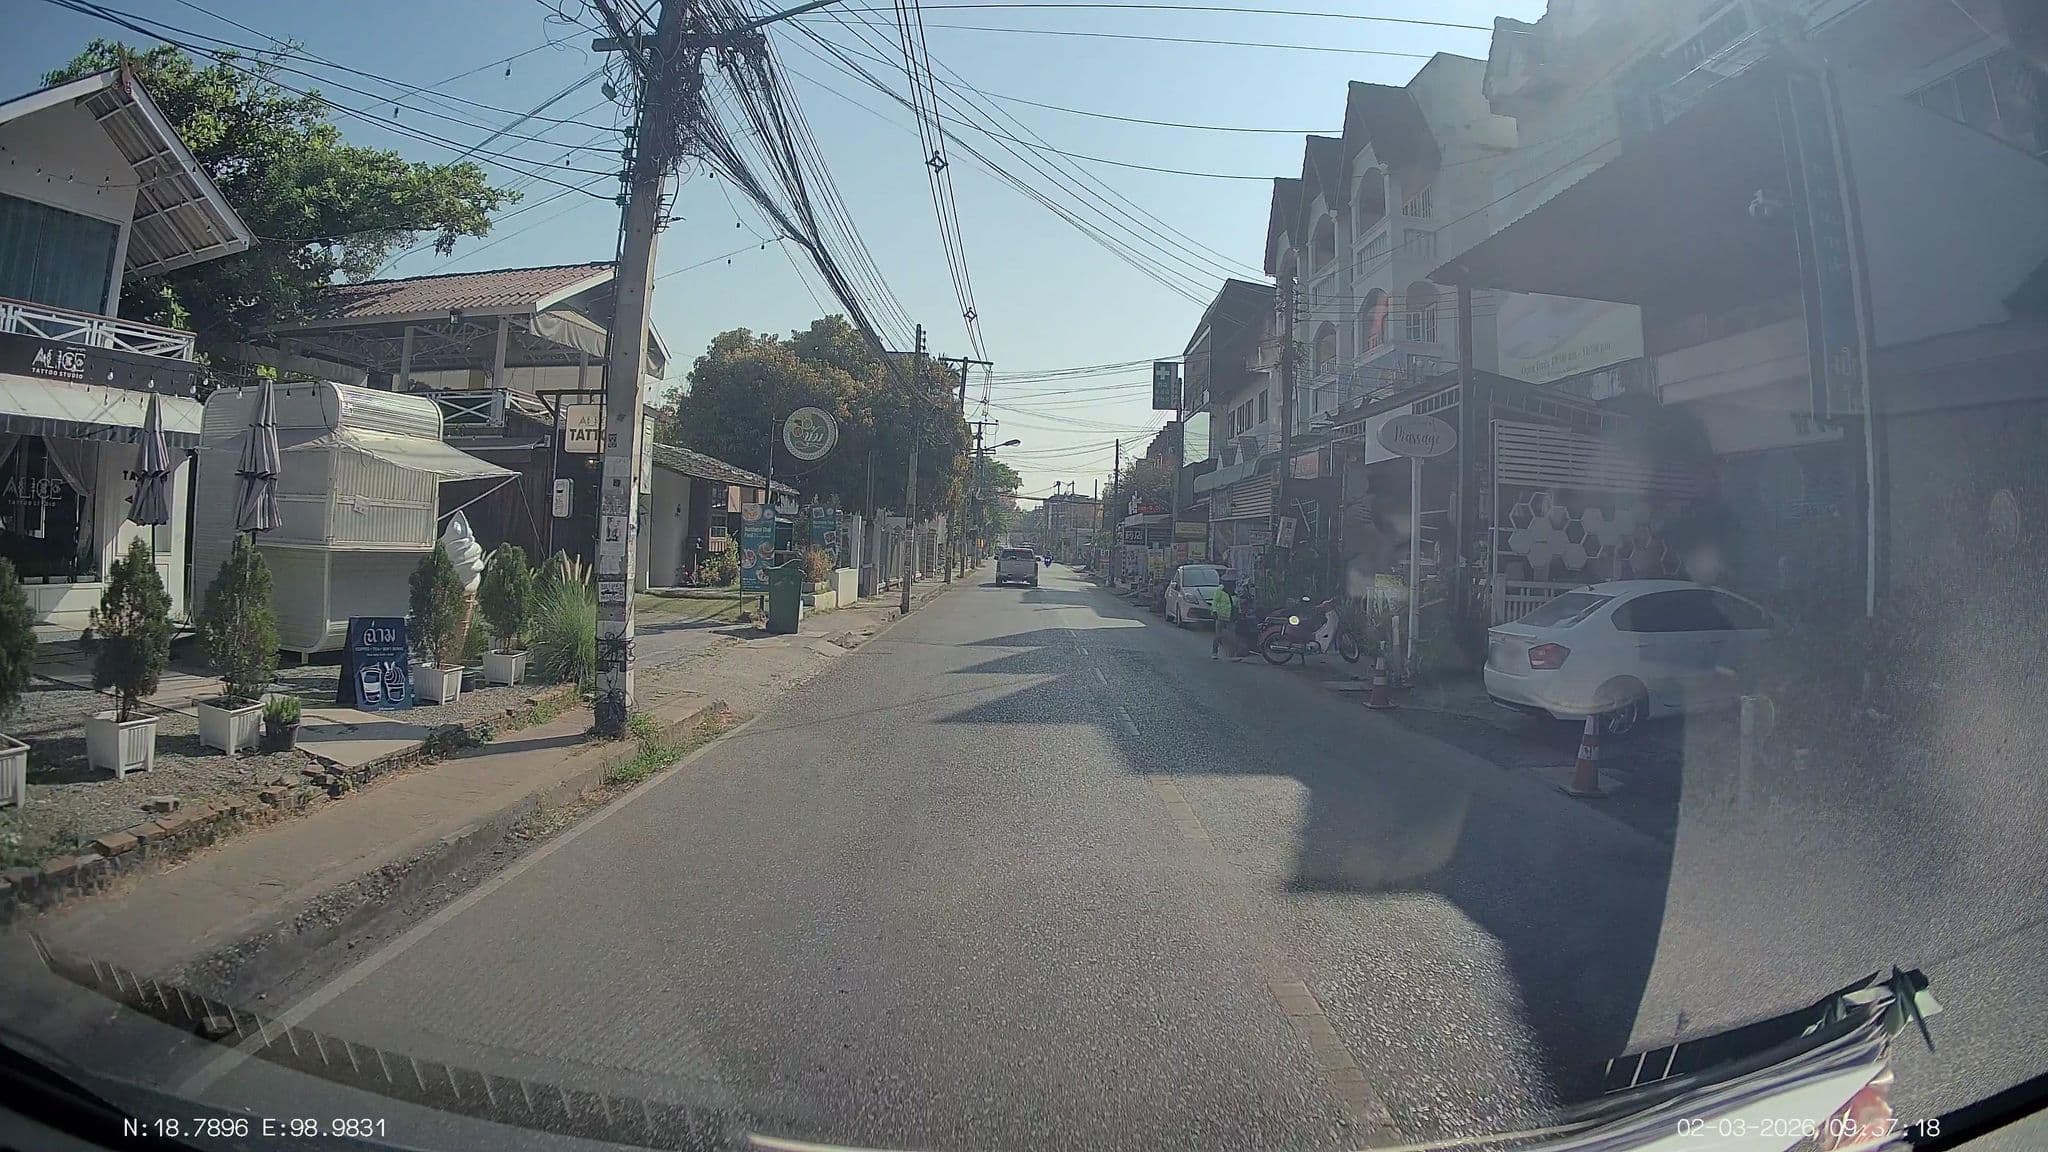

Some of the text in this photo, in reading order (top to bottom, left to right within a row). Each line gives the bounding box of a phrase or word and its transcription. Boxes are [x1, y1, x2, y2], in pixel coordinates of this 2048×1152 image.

[32, 367, 84, 380] TATTOO STUDIO
[578, 416, 598, 426] ALI
[363, 620, 396, 646] ฉ่าม
